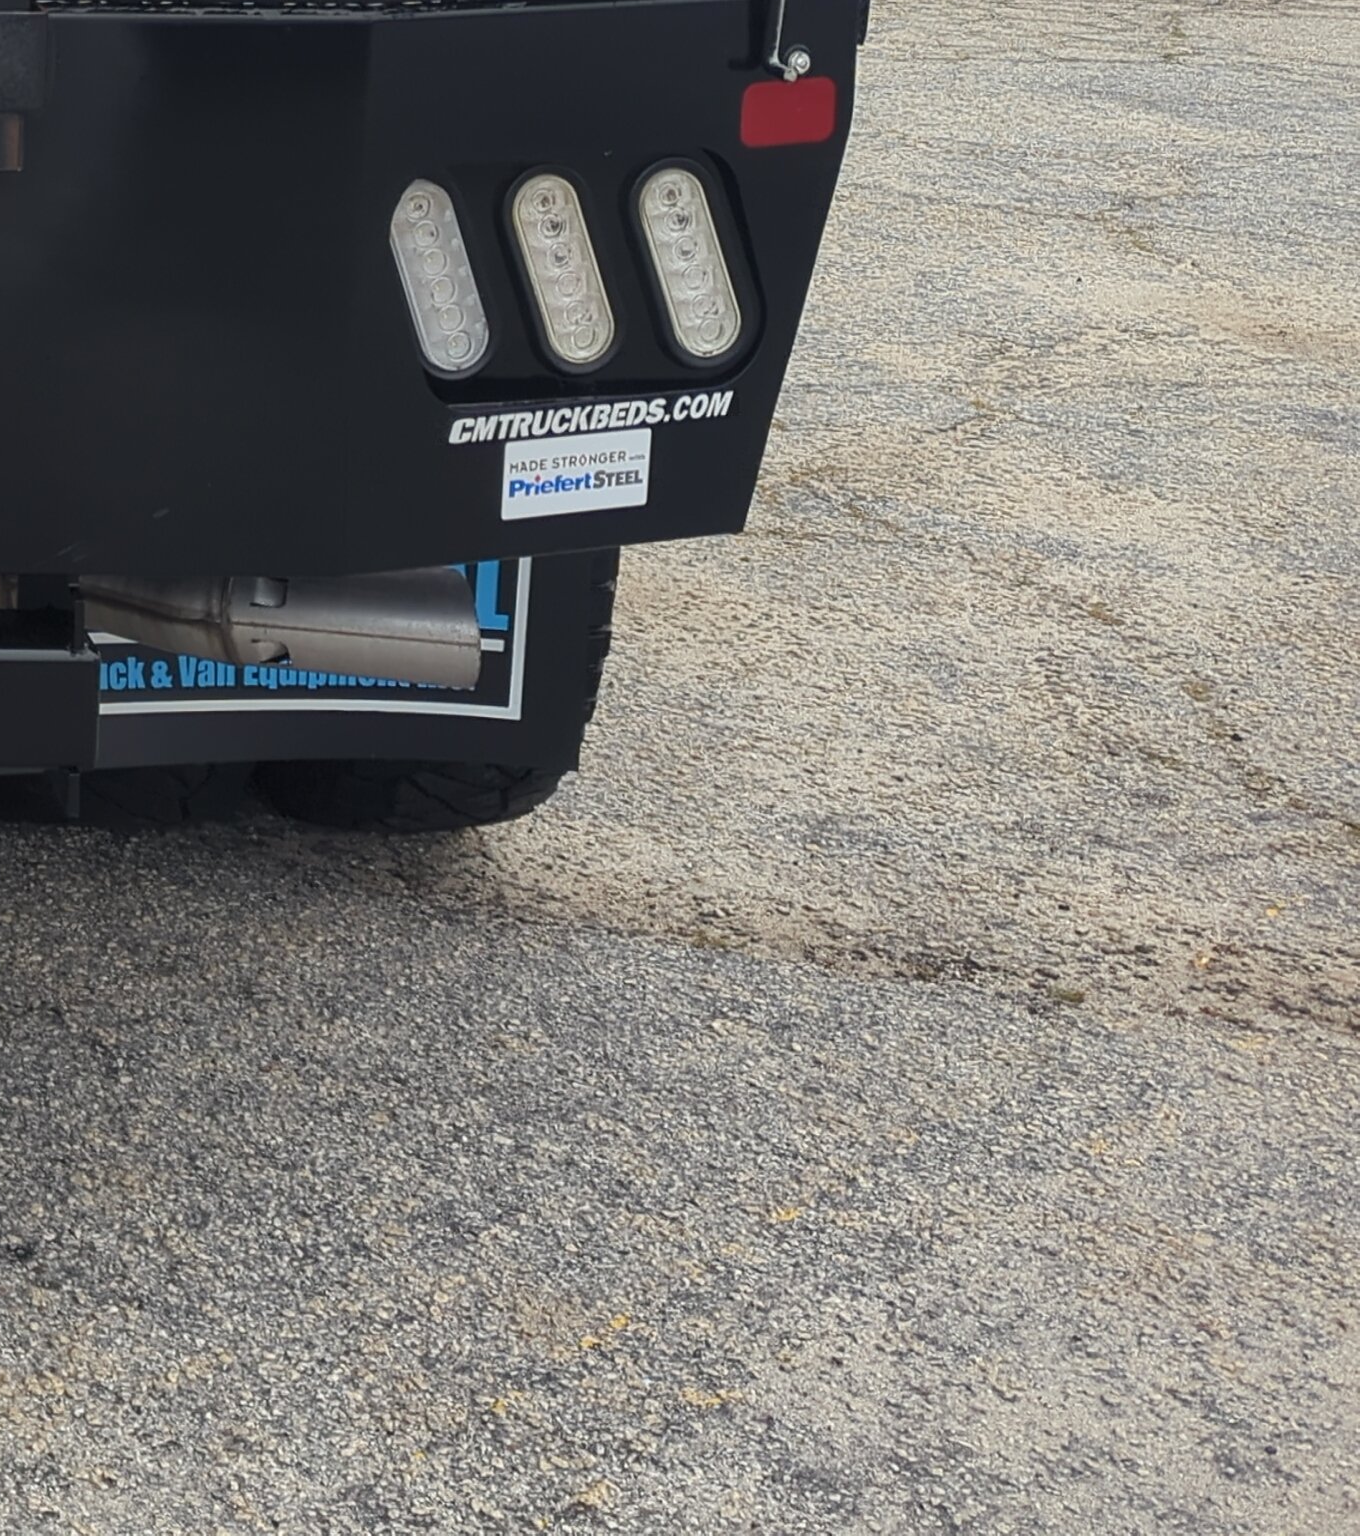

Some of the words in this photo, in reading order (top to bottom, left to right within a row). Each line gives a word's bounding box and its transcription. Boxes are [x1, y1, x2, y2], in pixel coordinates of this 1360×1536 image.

[448, 390, 734, 444] CMTRUCKBEDS.COM
[509, 458, 548, 474] MADE
[552, 450, 627, 469] STRONGER
[151, 660, 173, 689] &
[178, 655, 236, 688] Van
